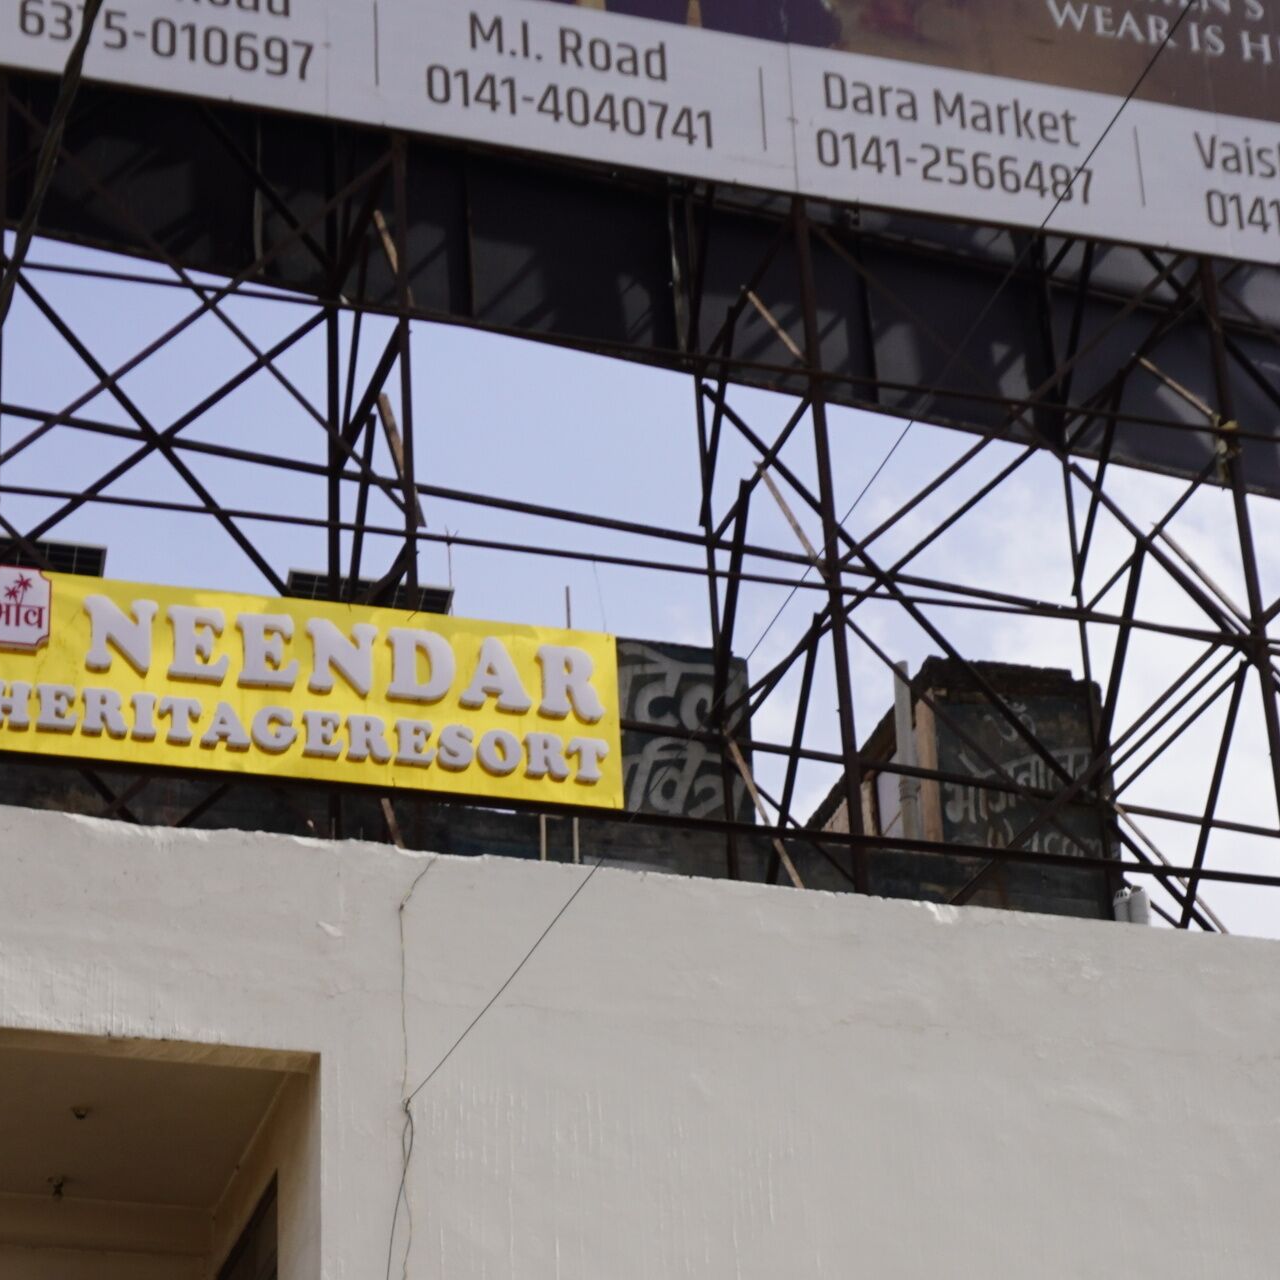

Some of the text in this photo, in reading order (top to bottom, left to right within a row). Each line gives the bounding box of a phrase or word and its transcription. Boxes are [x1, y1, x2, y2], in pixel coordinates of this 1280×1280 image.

[18, 0, 315, 82] 635-010697
[468, 11, 669, 82] M.I. Road
[1045, 0, 1176, 49] WEAR
[1188, 21, 1226, 56] IS
[425, 63, 714, 150] 0141-4040741
[822, 71, 1080, 148] Dara Market
[815, 127, 1094, 205] 0141-2566487
[83, 593, 607, 725] NEENDAR
